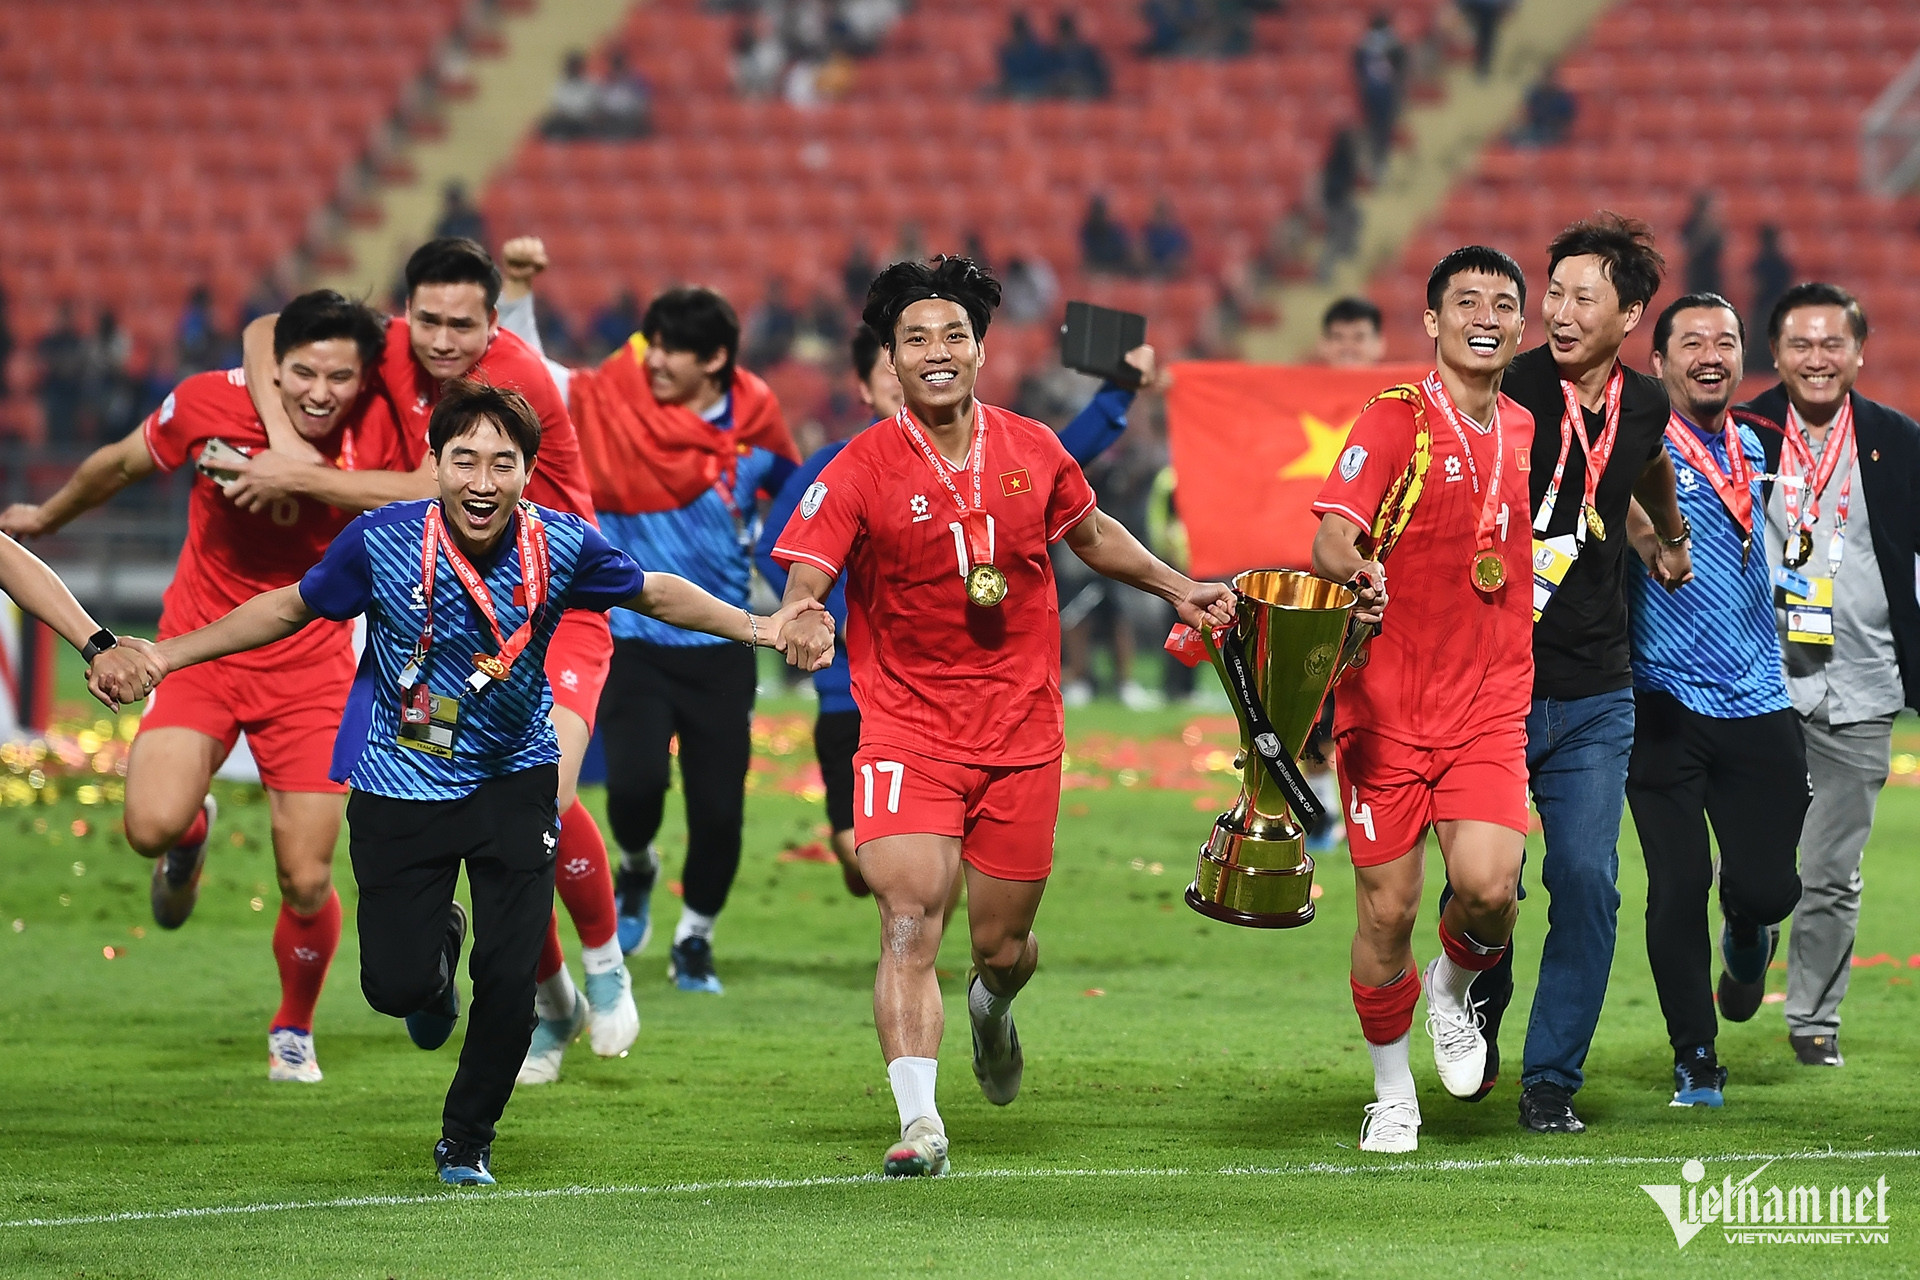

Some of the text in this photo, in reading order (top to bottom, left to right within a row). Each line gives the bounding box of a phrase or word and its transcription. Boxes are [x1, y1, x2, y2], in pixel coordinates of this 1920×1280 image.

[902, 414, 967, 510] MITSUBISHI ELECTRIC CUP 2024
[972, 441, 982, 475] ELECTRIC
[1454, 424, 1472, 457] ELECTRIC
[1467, 456, 1476, 474] CUP
[1472, 474, 1480, 494] 2024
[973, 476, 981, 491] CUP
[973, 491, 981, 509] 2024
[426, 518, 435, 553] MITSUBISHI
[424, 554, 432, 586] ELECTRIC
[523, 547, 535, 582] ELECTRIC
[453, 555, 478, 587] ELECTRIC
[474, 584, 488, 601] CUP
[484, 602, 497, 620] 2024
[528, 582, 537, 599] CUP
[1234, 658, 1258, 722] ELECTRIC CUP 2024
[861, 761, 905, 818] 17
[1290, 780, 1306, 803] ELECTRIC
[1303, 802, 1314, 813] CUP
[1350, 785, 1376, 841] 4
